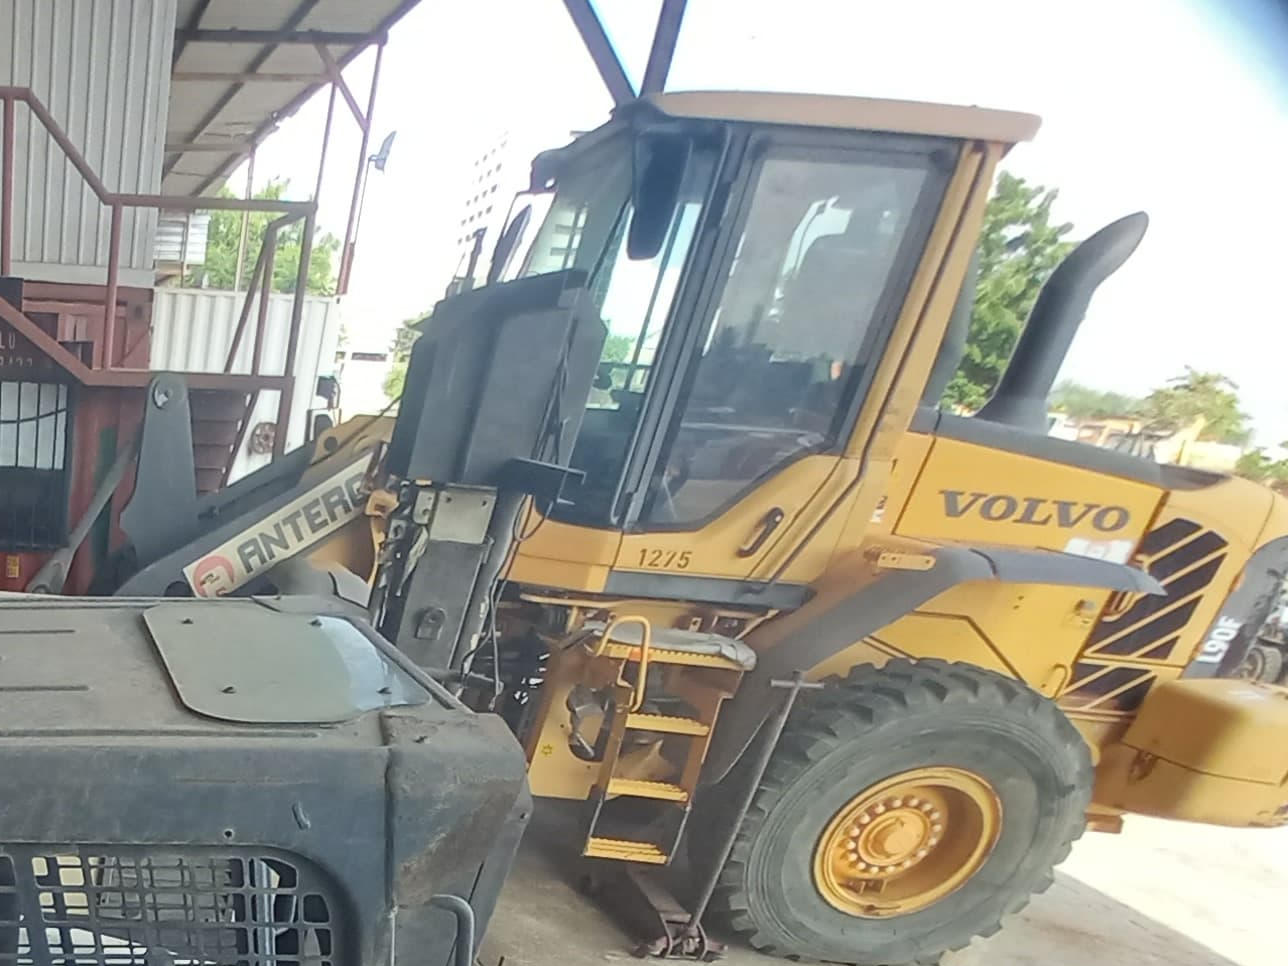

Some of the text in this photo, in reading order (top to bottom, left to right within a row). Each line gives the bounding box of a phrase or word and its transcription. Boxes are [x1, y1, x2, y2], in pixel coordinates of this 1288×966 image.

[938, 489, 1131, 532] VOLVO
[639, 548, 692, 569] 1275
[1196, 615, 1244, 663] L90F
